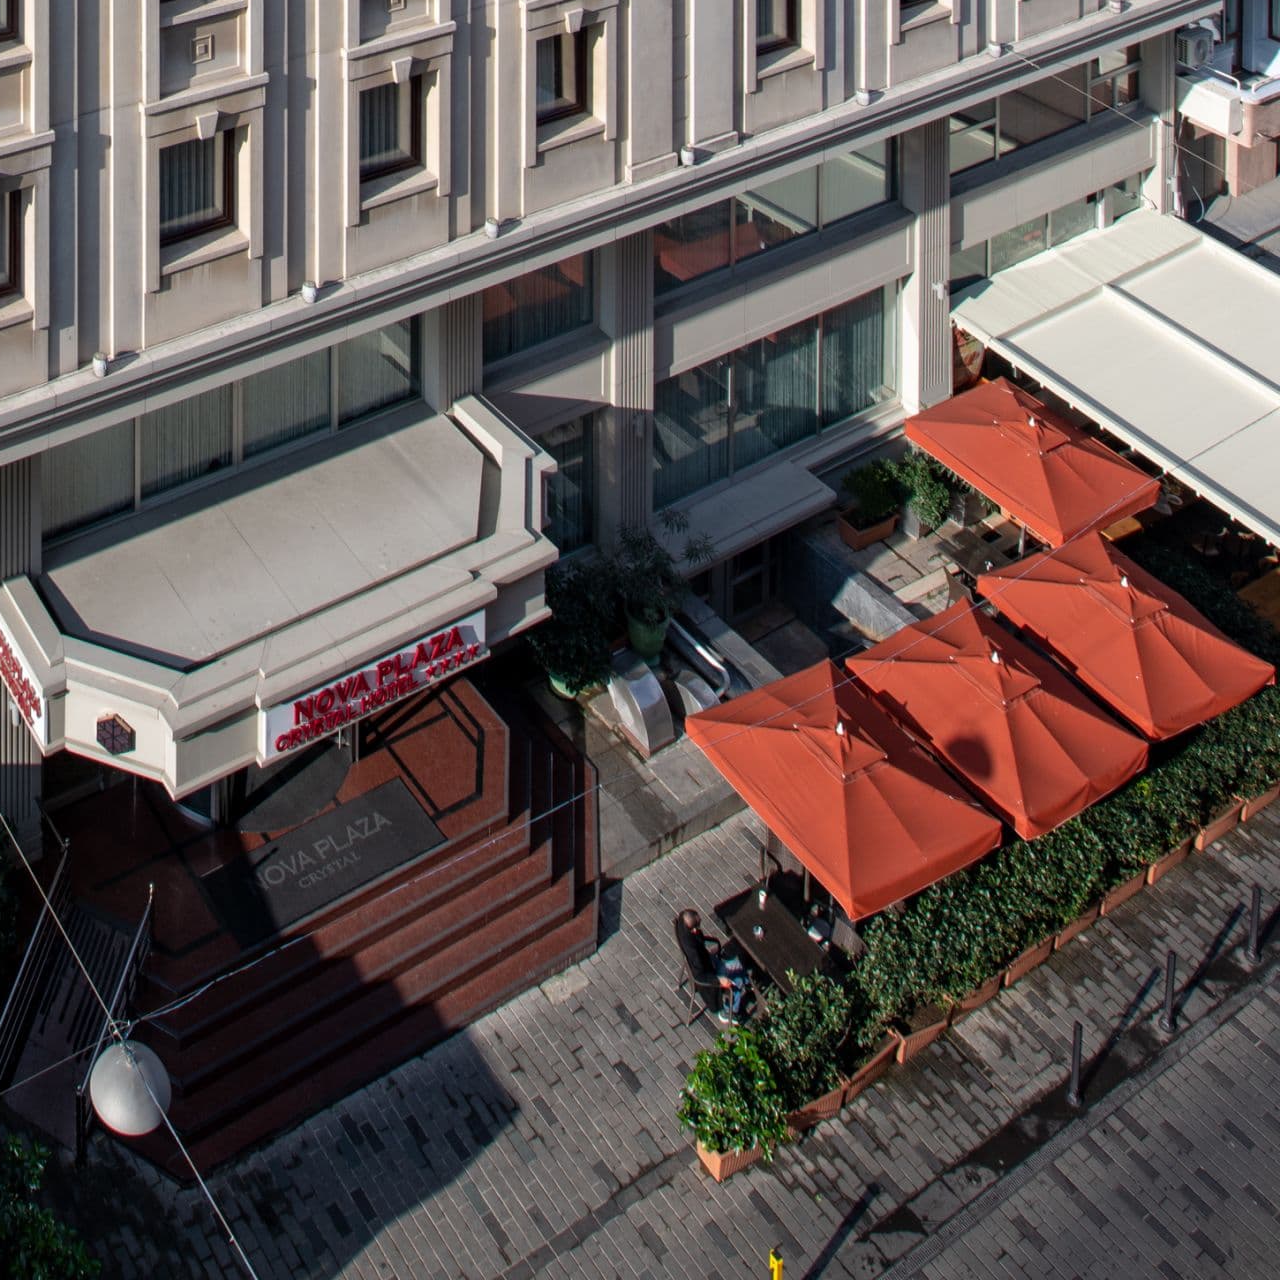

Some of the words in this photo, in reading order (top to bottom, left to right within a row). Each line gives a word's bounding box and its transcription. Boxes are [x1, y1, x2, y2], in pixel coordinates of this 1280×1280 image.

[293, 671, 370, 726] NOVA
[376, 626, 465, 686] PLAZA
[275, 702, 361, 752] CRYSTAL
[360, 673, 420, 715] HOTEL
[312, 811, 393, 860] PLAZA
[298, 851, 362, 889] CRYSTAL
